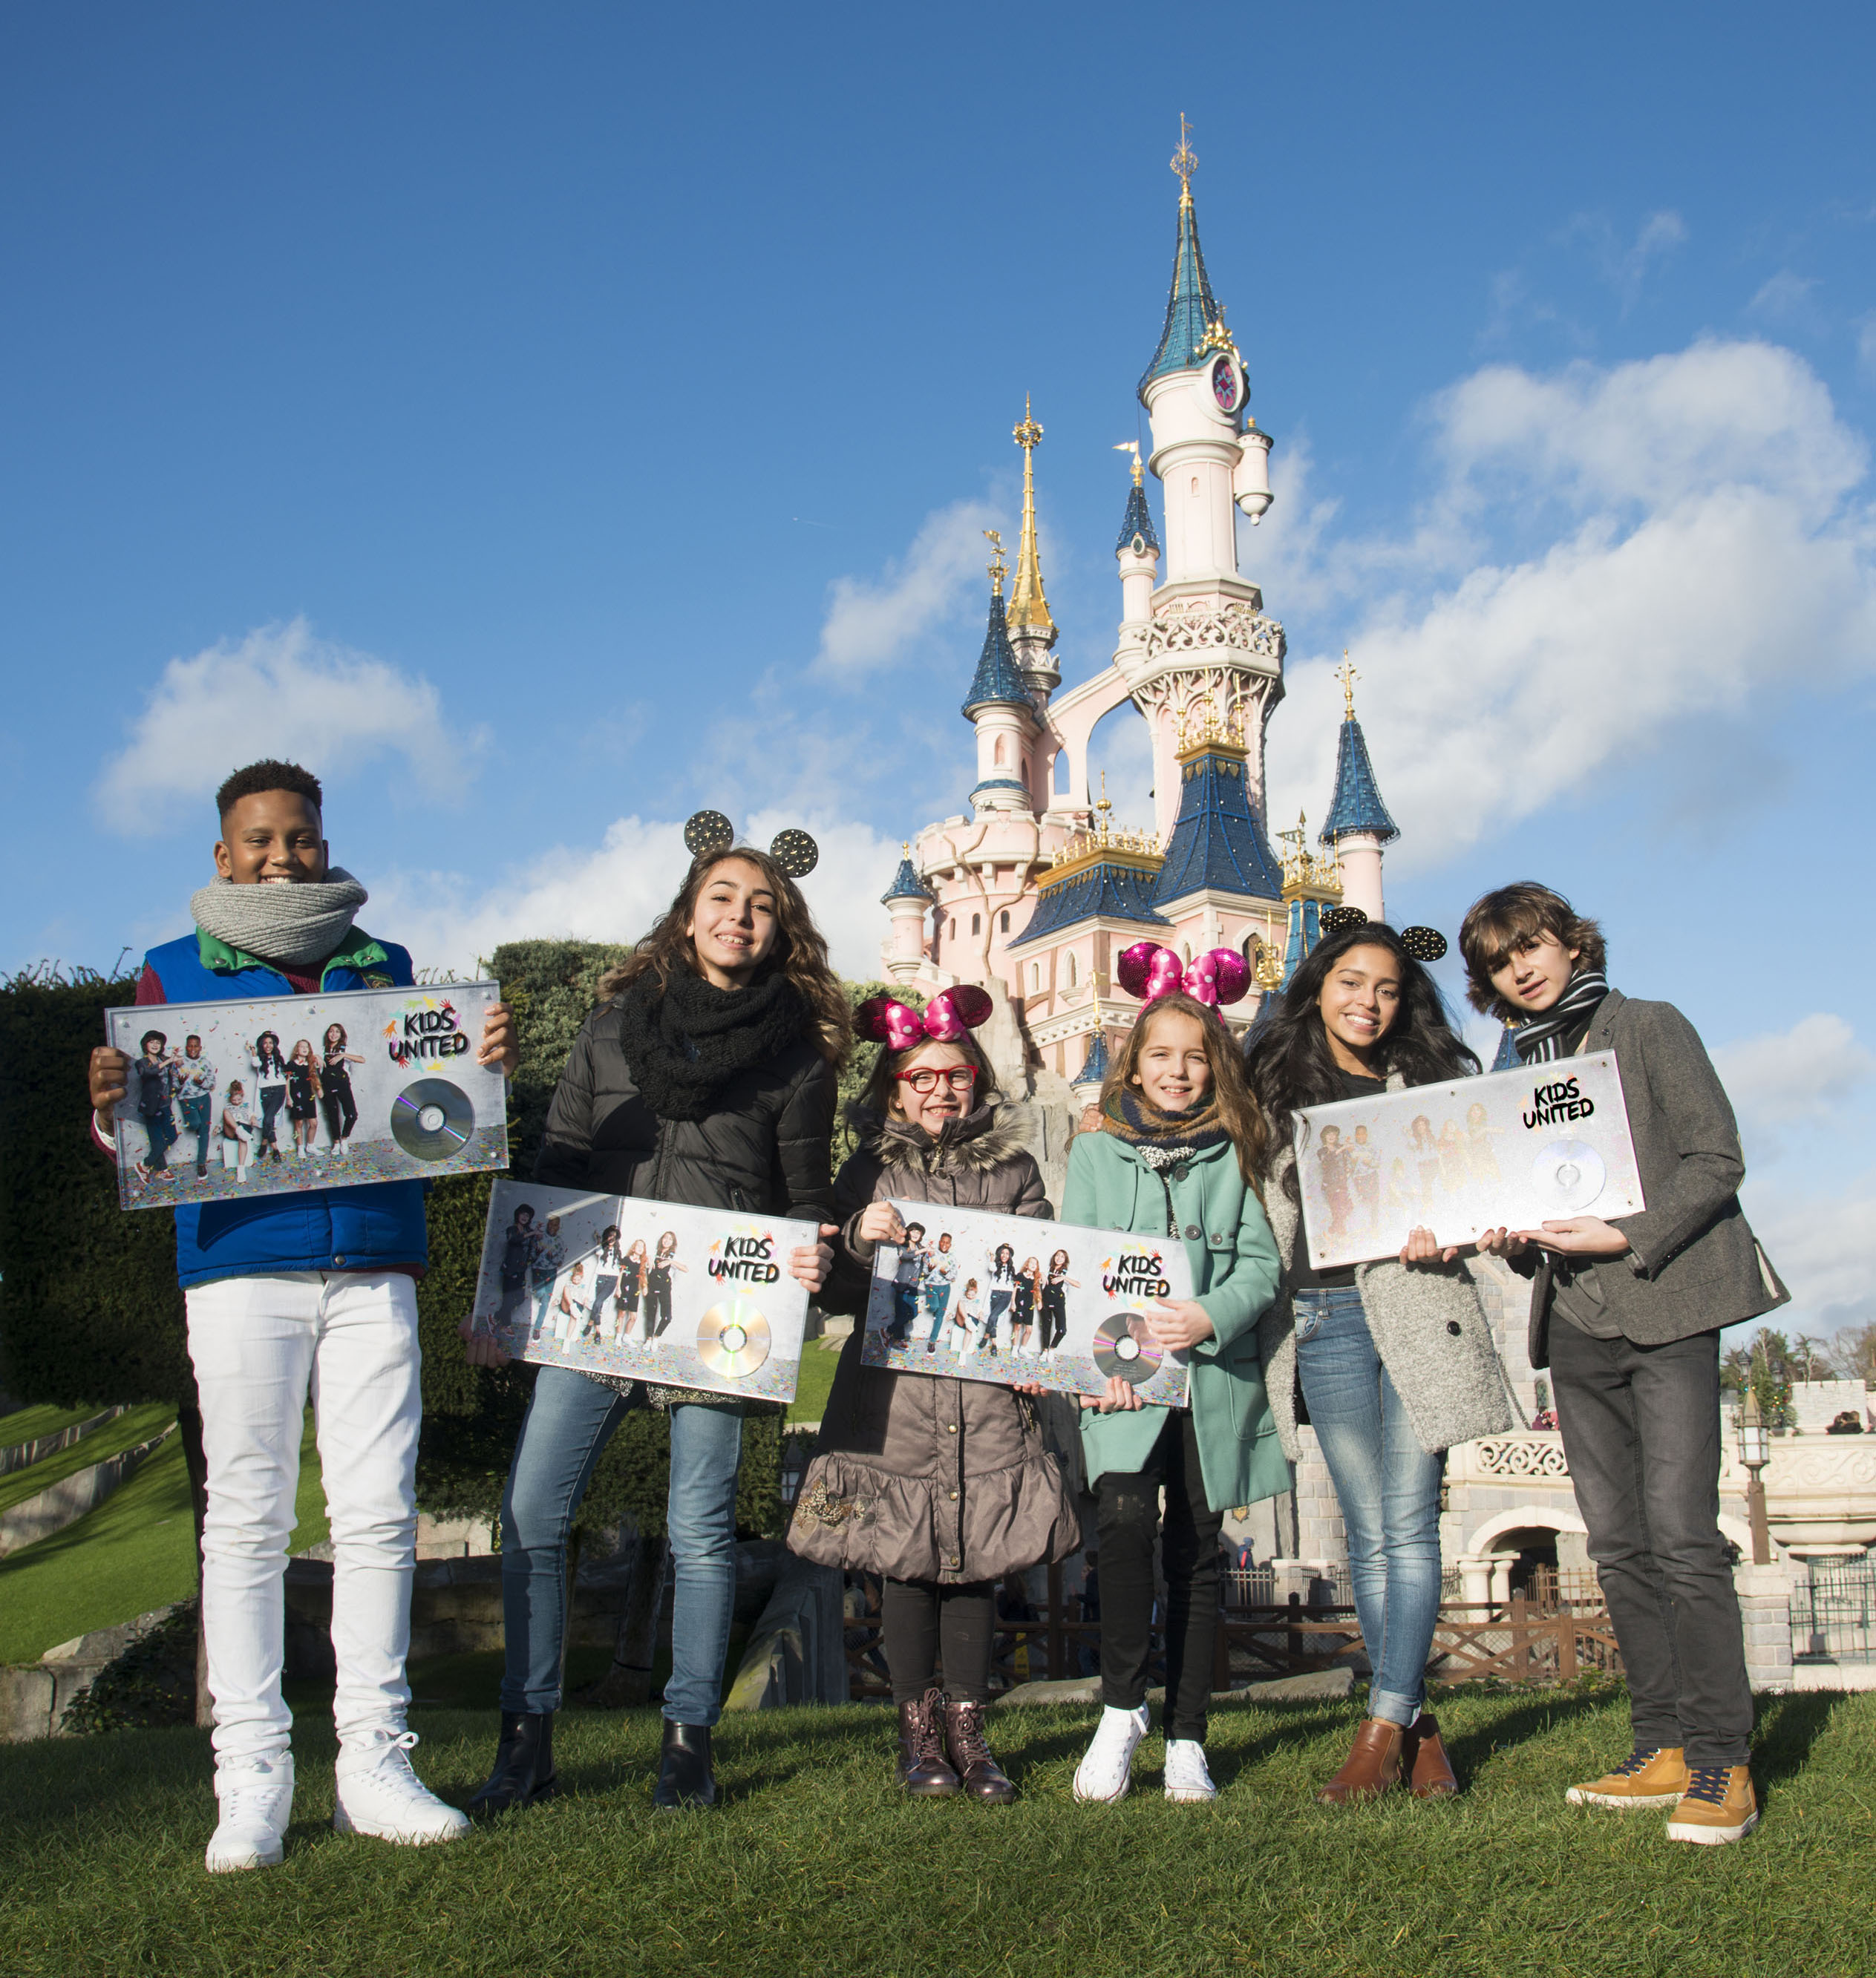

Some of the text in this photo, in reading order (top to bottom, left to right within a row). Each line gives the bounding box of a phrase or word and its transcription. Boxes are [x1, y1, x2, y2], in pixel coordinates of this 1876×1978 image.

[404, 1007, 456, 1037] KIDS
[389, 1032, 470, 1061] UNITED
[1535, 1077, 1580, 1108] KIDS
[1523, 1098, 1595, 1129] UNITED
[725, 1237, 773, 1260] KIDS
[708, 1258, 780, 1283] UNITED
[1118, 1254, 1163, 1276] KIDS
[1102, 1274, 1171, 1297] UNITED
